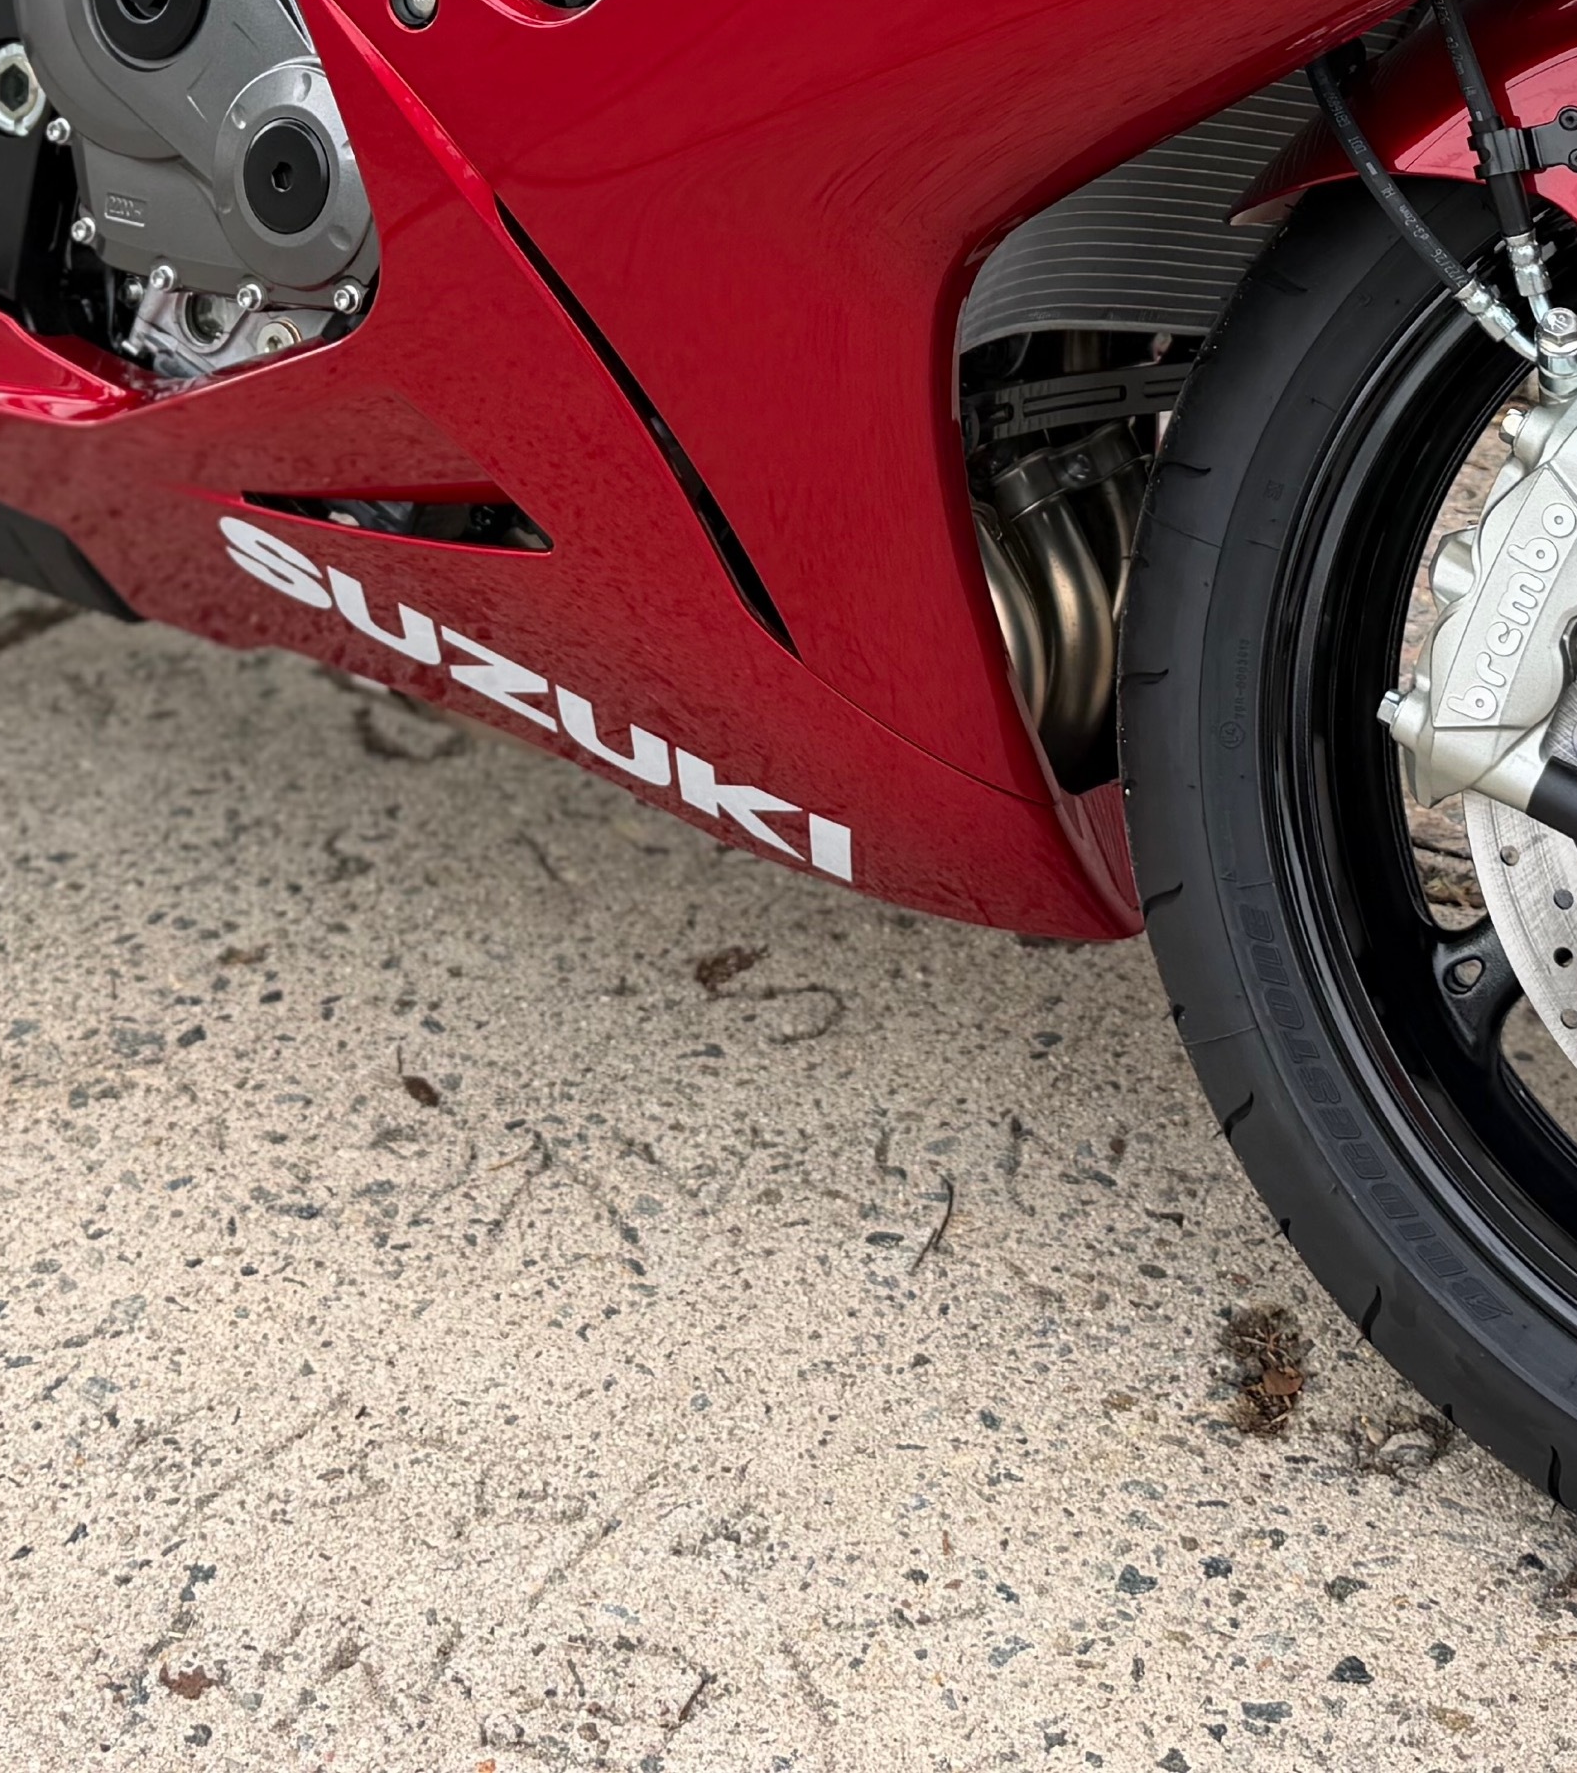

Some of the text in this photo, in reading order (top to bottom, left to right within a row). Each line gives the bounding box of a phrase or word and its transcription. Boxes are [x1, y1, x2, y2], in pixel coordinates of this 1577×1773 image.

[219, 516, 853, 882] SUZUKI
[1447, 502, 1577, 721] brembo
[1241, 907, 1512, 1322] BRIDGESTONE
